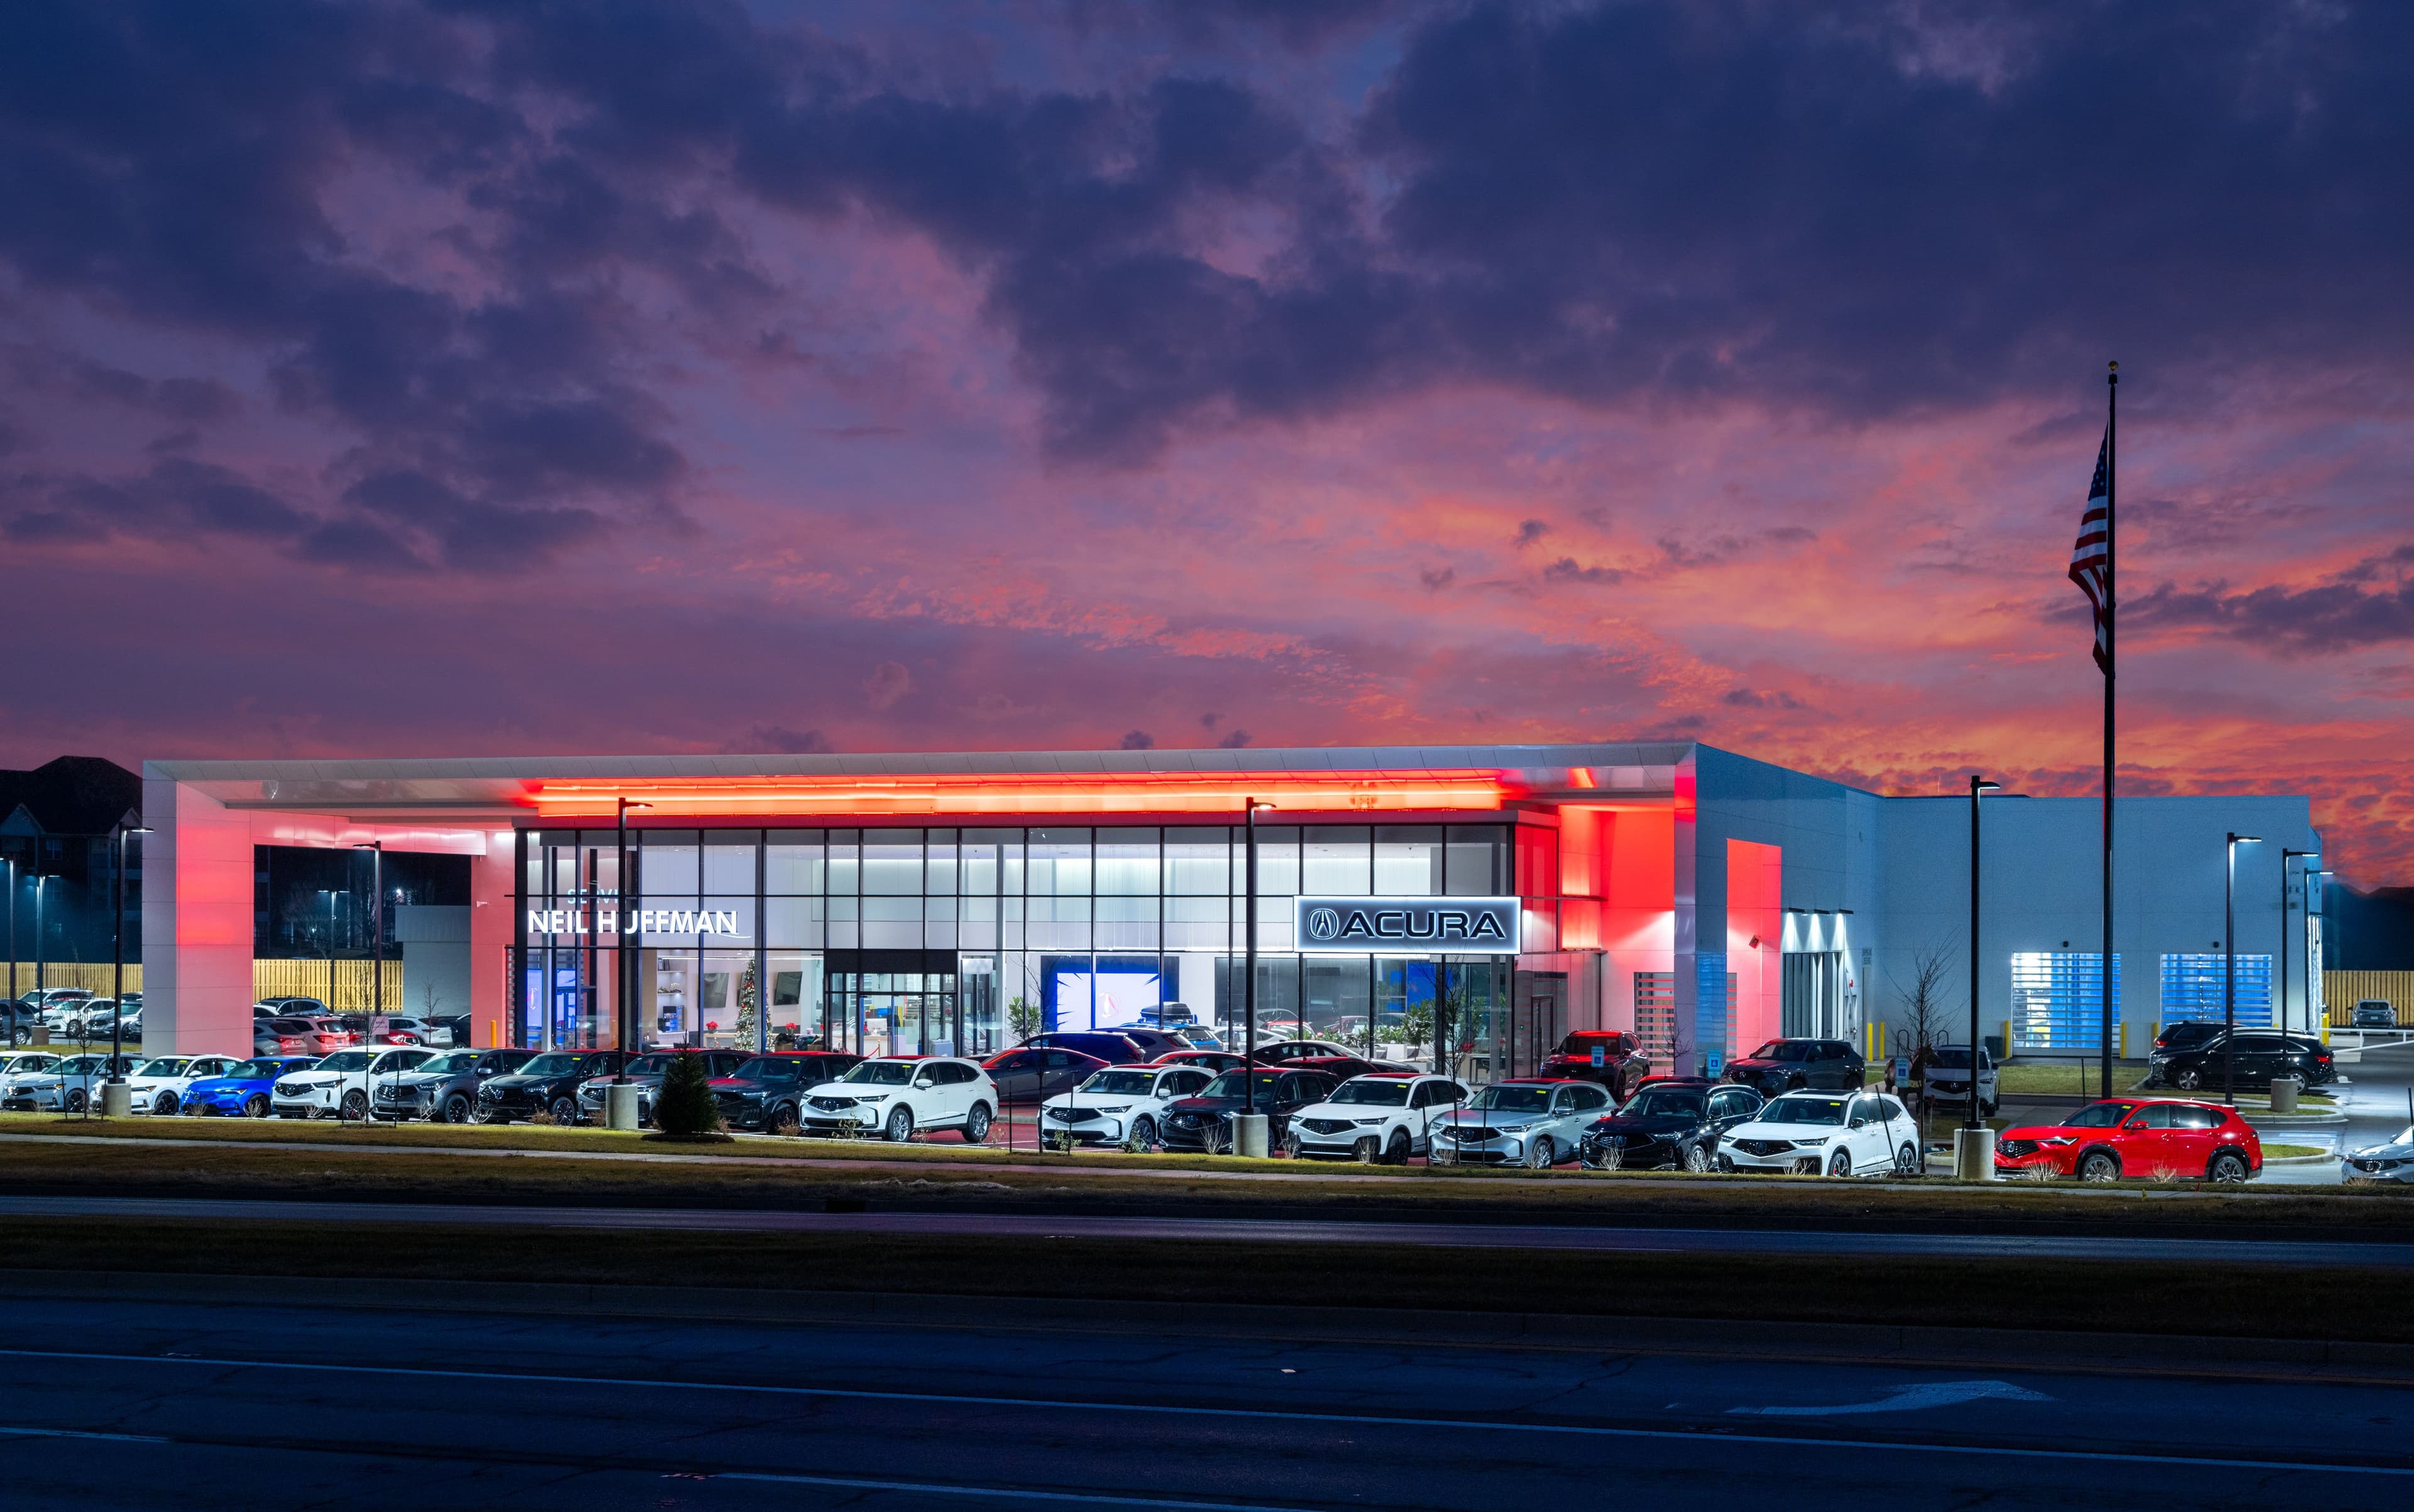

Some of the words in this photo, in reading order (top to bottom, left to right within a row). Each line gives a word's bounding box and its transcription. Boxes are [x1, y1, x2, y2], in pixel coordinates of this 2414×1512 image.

[528, 910, 588, 934] NEIL
[598, 910, 738, 934] HUFFMAN
[1340, 911, 1506, 938] ACURA
